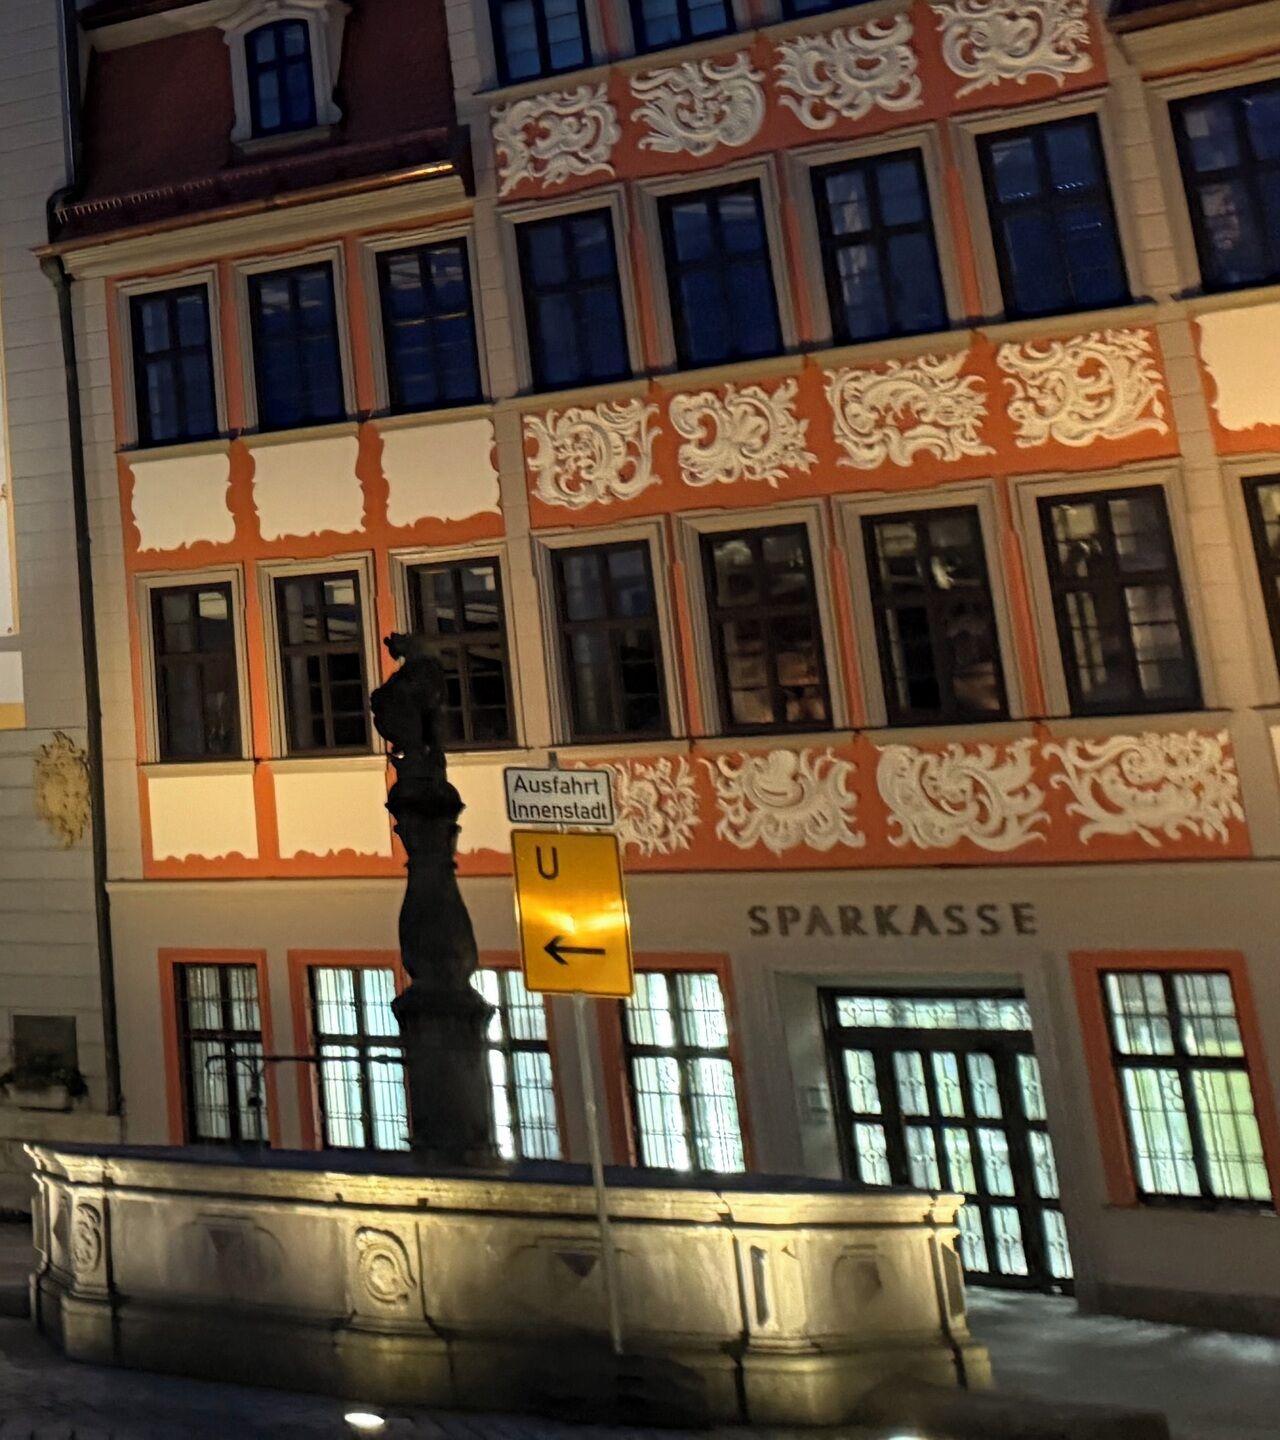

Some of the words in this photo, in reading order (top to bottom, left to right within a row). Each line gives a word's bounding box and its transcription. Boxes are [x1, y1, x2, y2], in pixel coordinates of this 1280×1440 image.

[513, 773, 600, 796] Ausfahrt
[511, 798, 608, 820] Innenstadt
[535, 845, 559, 880] U
[746, 902, 1038, 938] SPARKASSE
